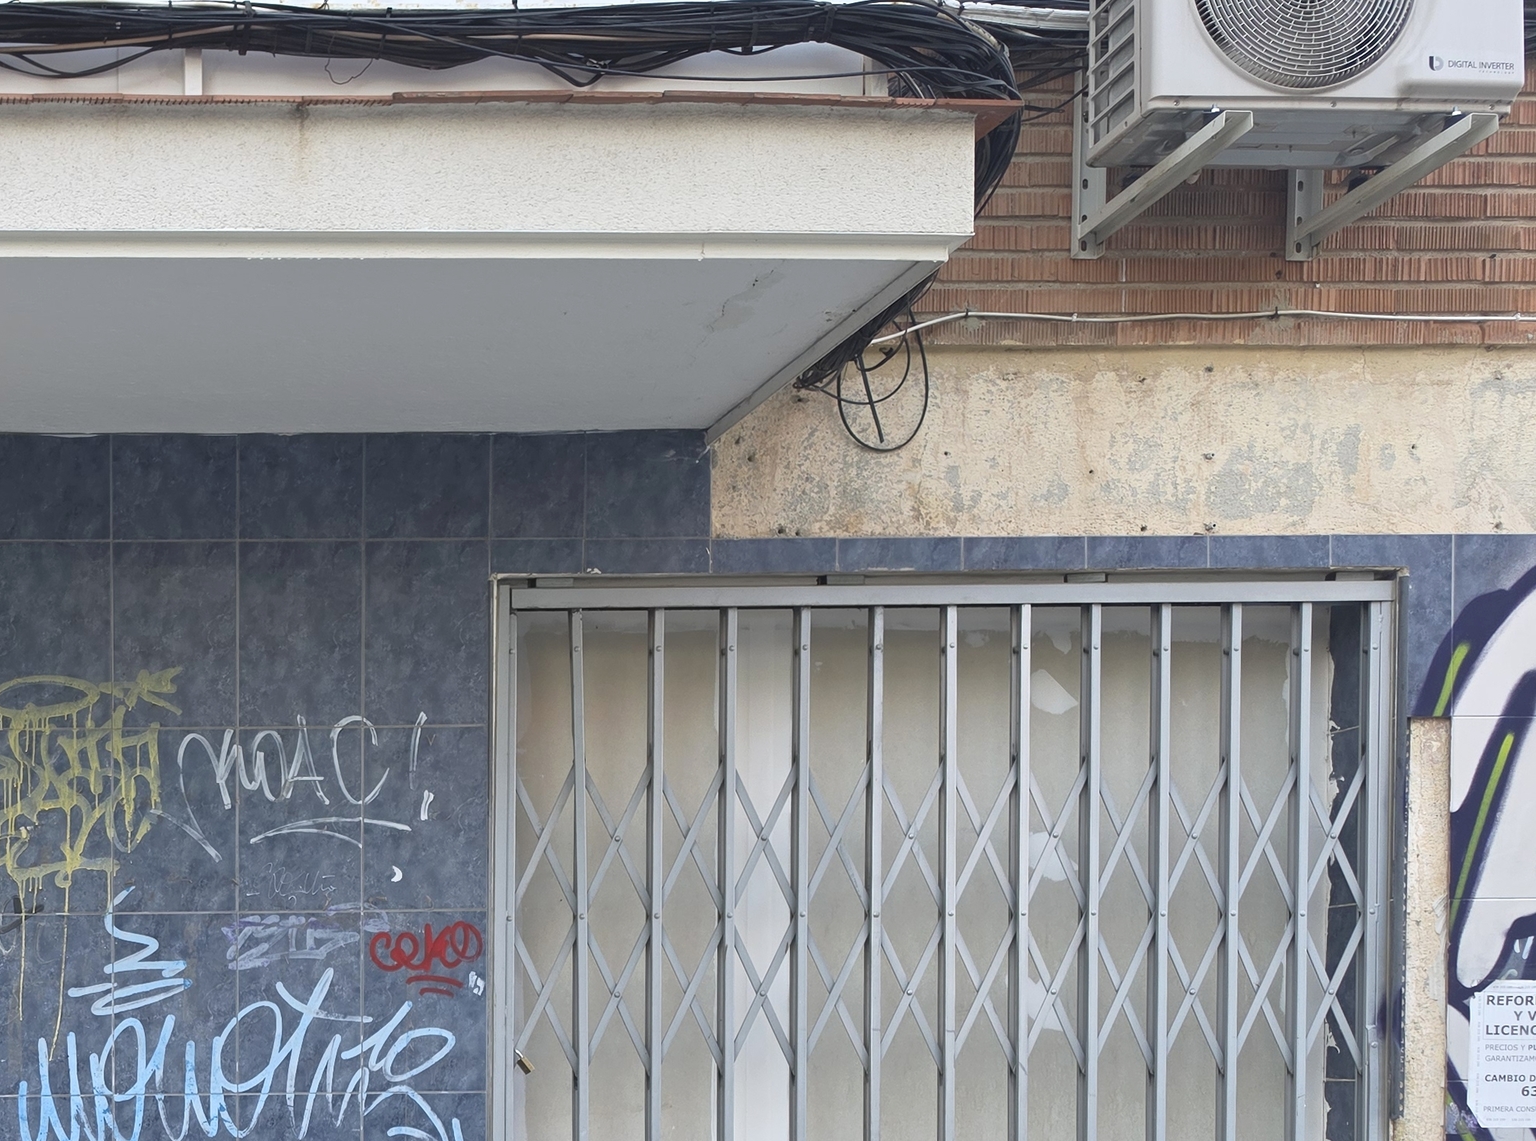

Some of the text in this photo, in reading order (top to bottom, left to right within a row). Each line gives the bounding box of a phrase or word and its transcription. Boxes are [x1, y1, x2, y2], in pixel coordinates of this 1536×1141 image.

[1448, 60, 1515, 70] DIGITAL INVERTER
[1487, 995, 1536, 1006] REFOR
[1514, 1011, 1523, 1021] Y
[1486, 1025, 1536, 1035] LICENC
[1485, 1074, 1526, 1082] CAMBIO
[1521, 1086, 1536, 1096] 63
